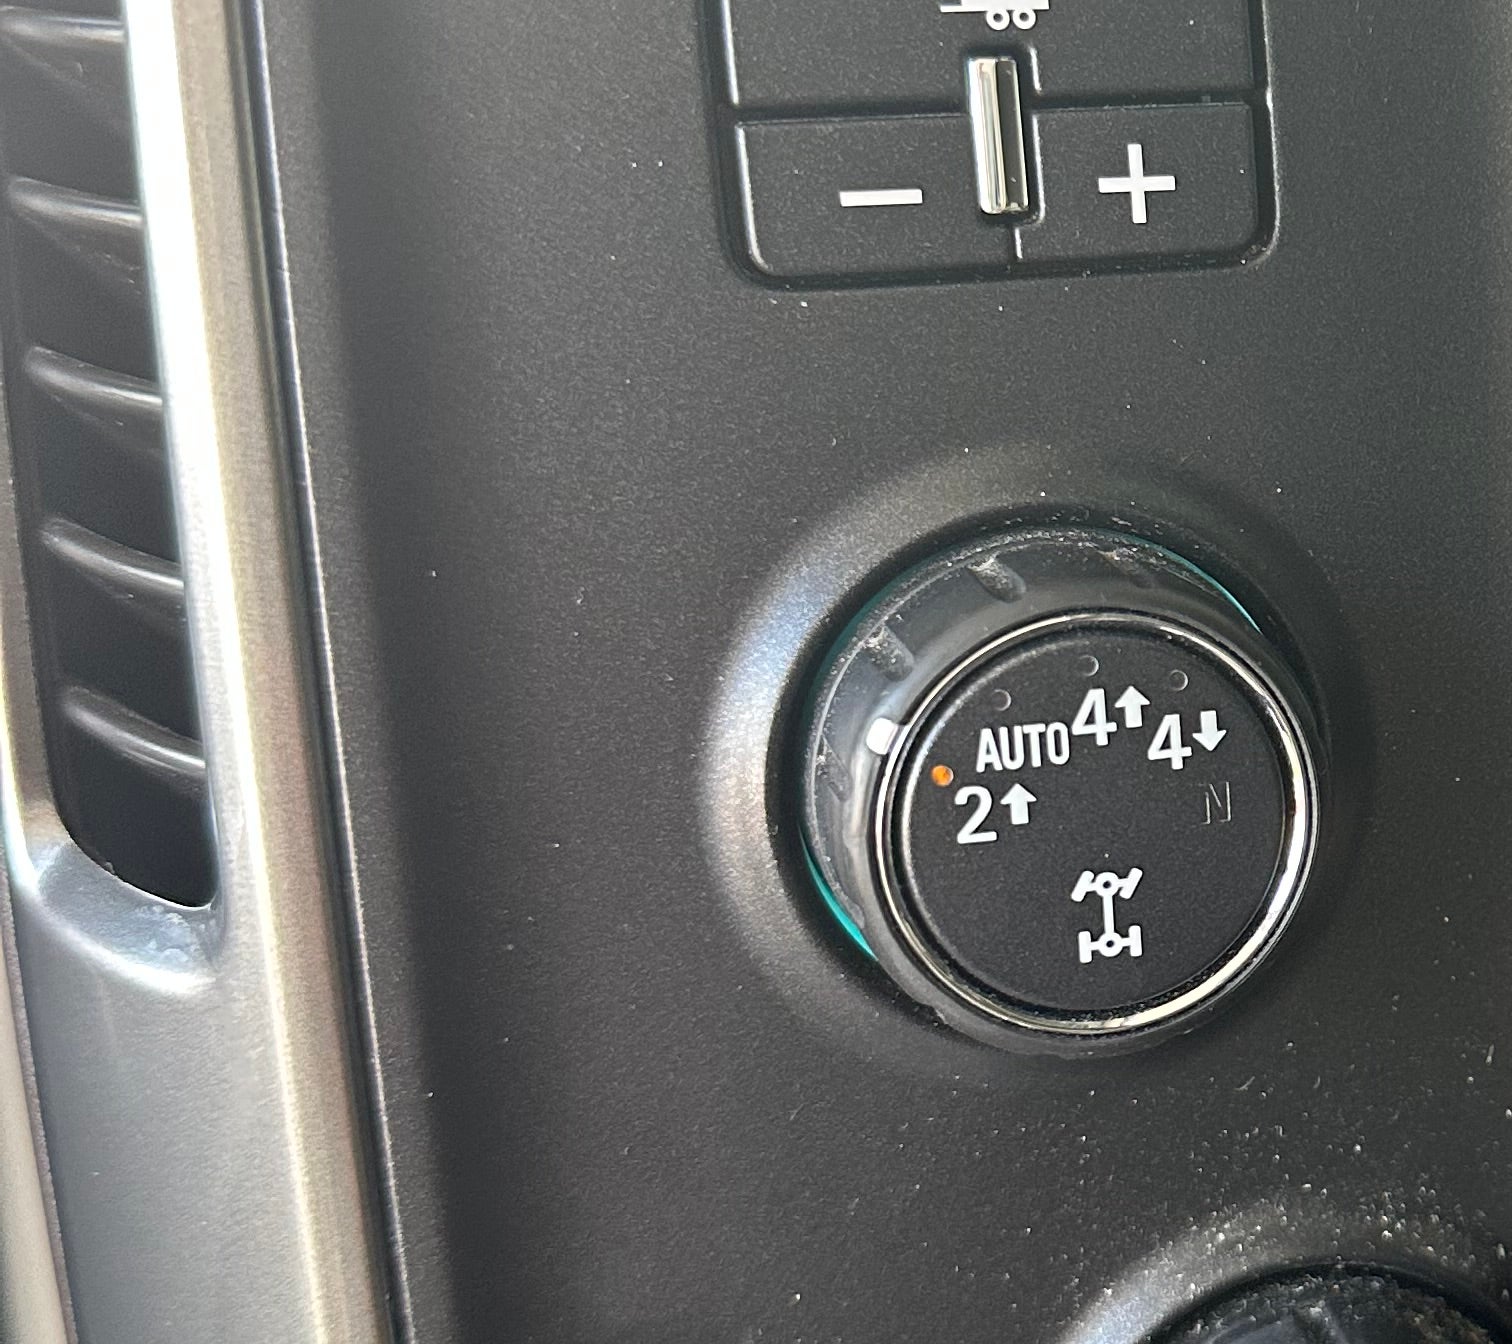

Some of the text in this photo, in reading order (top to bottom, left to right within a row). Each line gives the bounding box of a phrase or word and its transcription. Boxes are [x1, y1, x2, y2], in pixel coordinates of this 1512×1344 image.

[1071, 688, 1117, 747] 4
[1147, 713, 1192, 770] 4
[976, 721, 1070, 773] AUTO
[954, 785, 998, 845] 2
